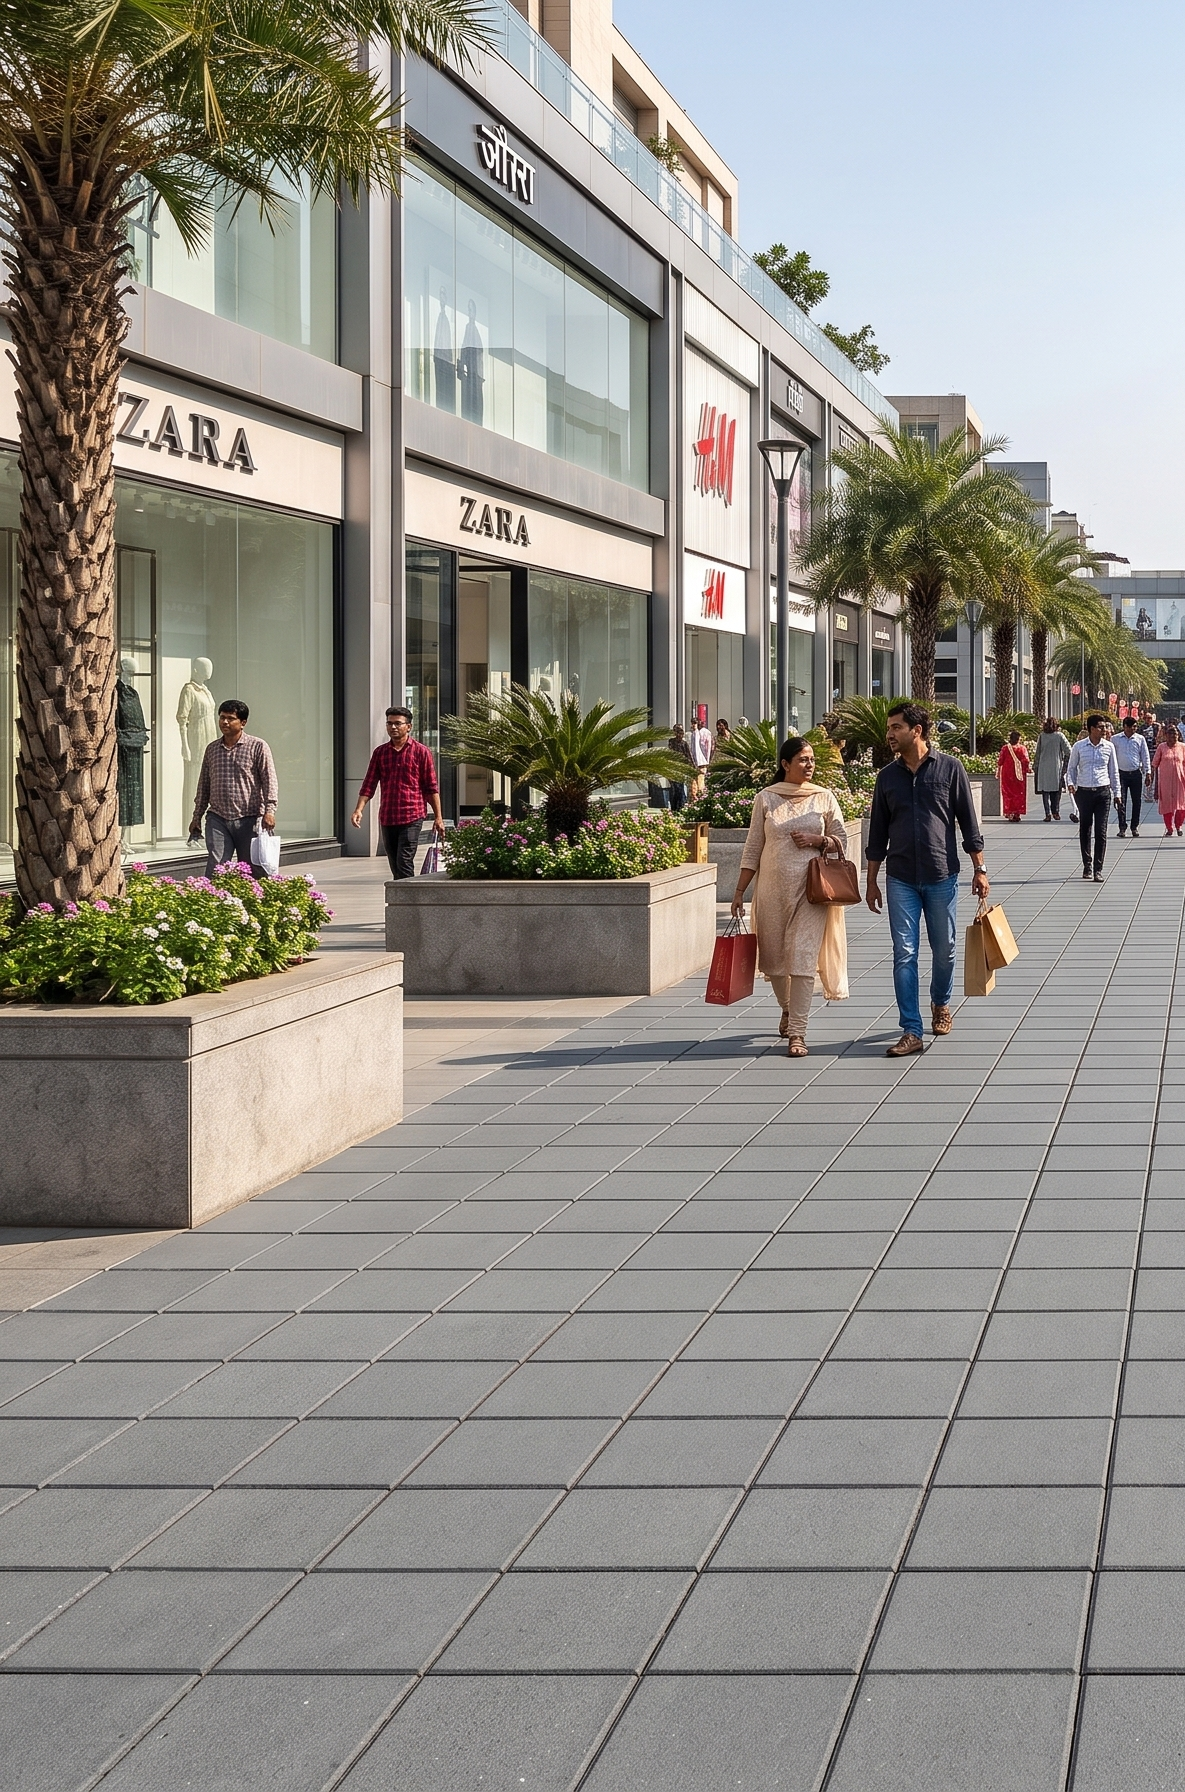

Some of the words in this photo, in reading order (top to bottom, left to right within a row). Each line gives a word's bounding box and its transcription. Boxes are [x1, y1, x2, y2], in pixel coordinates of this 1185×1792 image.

[116, 392, 258, 475] ZARA
[692, 402, 736, 507] H&M
[459, 496, 531, 547] ZARA
[702, 568, 726, 619] H&M
